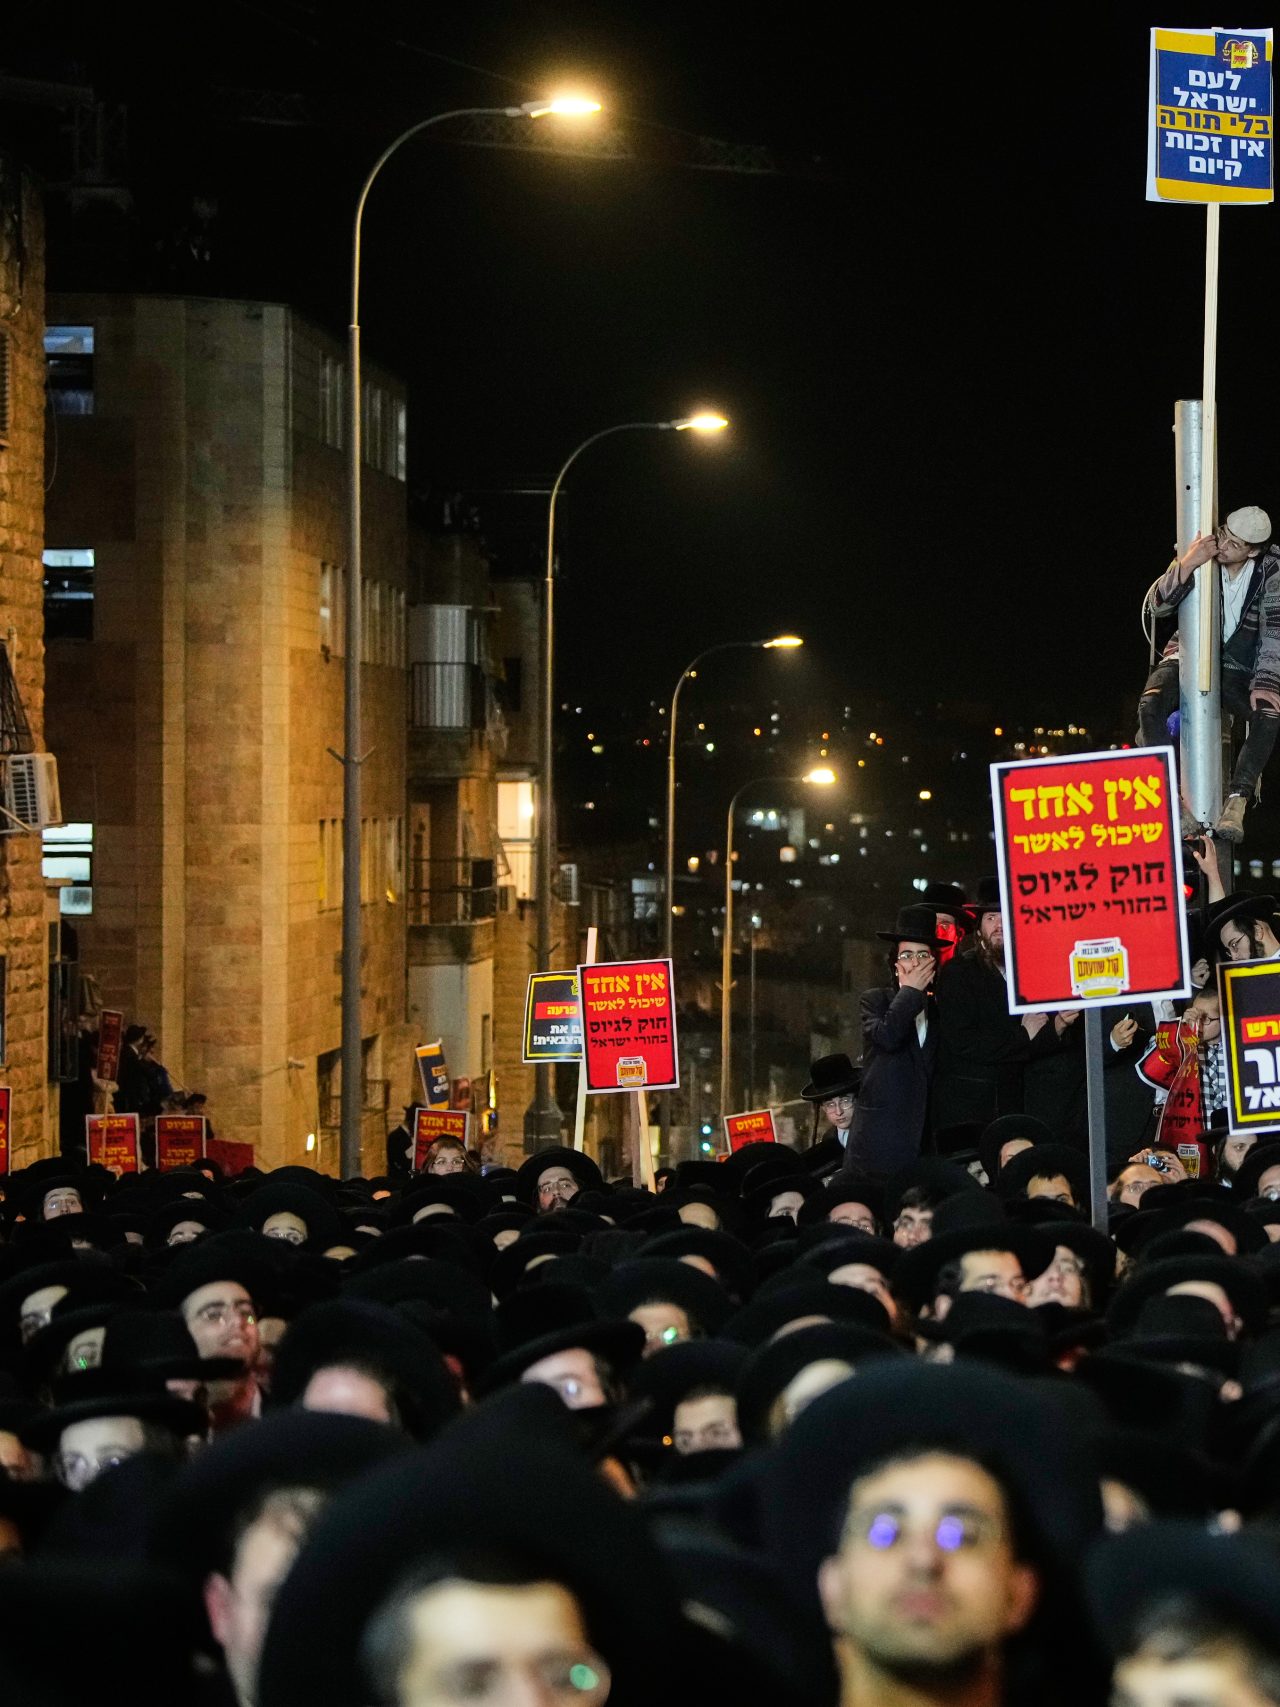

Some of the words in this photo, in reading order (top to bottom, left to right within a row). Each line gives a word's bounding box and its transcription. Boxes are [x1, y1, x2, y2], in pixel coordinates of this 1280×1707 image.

[1189, 69, 1241, 91] לעם
[1173, 87, 1256, 113] ישראל
[1160, 109, 1221, 131] תורה
[1230, 114, 1269, 134] בלי
[1165, 131, 1222, 153] זכות
[1231, 138, 1264, 158] אין
[1189, 155, 1242, 180] קיום
[1010, 780, 1094, 821] אחד
[1104, 775, 1162, 821] אין
[1014, 826, 1085, 854] לאשר
[1091, 821, 1163, 848] שיכול
[1017, 863, 1099, 895] לגיוס
[1110, 861, 1165, 893] חוק
[1020, 902, 1096, 925] ישראל
[1104, 895, 1167, 915] בחורי
[1107, 958, 1119, 976] קול
[586, 975, 630, 994] אחד
[635, 973, 665, 995] אין
[587, 997, 625, 1011] לאשר
[628, 997, 666, 1009] שיכול
[550, 1024, 568, 1034] את
[589, 1017, 633, 1033] לגיוס
[638, 1016, 667, 1033] חוק
[590, 1037, 631, 1048] ישראל
[634, 1034, 668, 1045] בחורי
